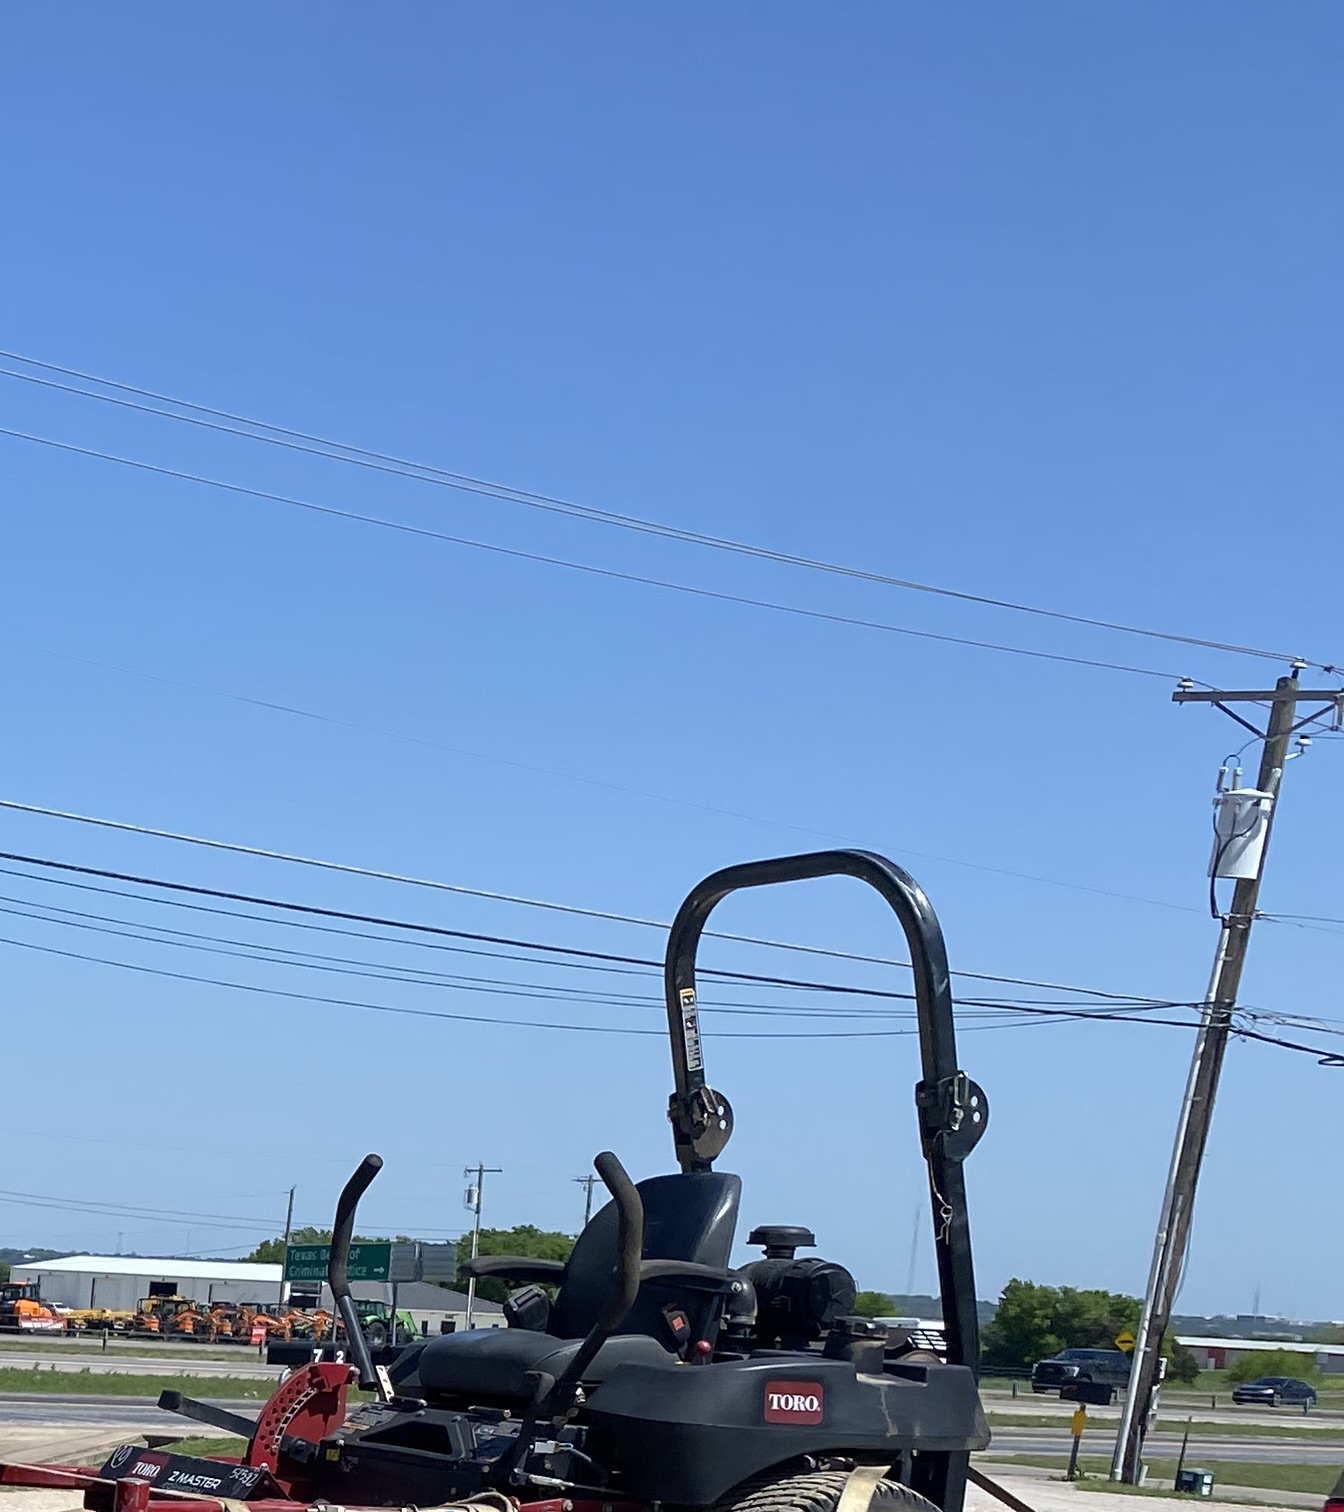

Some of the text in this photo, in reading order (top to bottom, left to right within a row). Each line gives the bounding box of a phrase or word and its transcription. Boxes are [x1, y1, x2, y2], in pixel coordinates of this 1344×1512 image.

[289, 1250, 317, 1261] Texas
[349, 1248, 361, 1261] of
[288, 1265, 328, 1277] Criminal
[768, 1393, 819, 1412] TORO
[132, 1462, 161, 1477] TORO
[167, 1470, 223, 1490] Z MASTER
